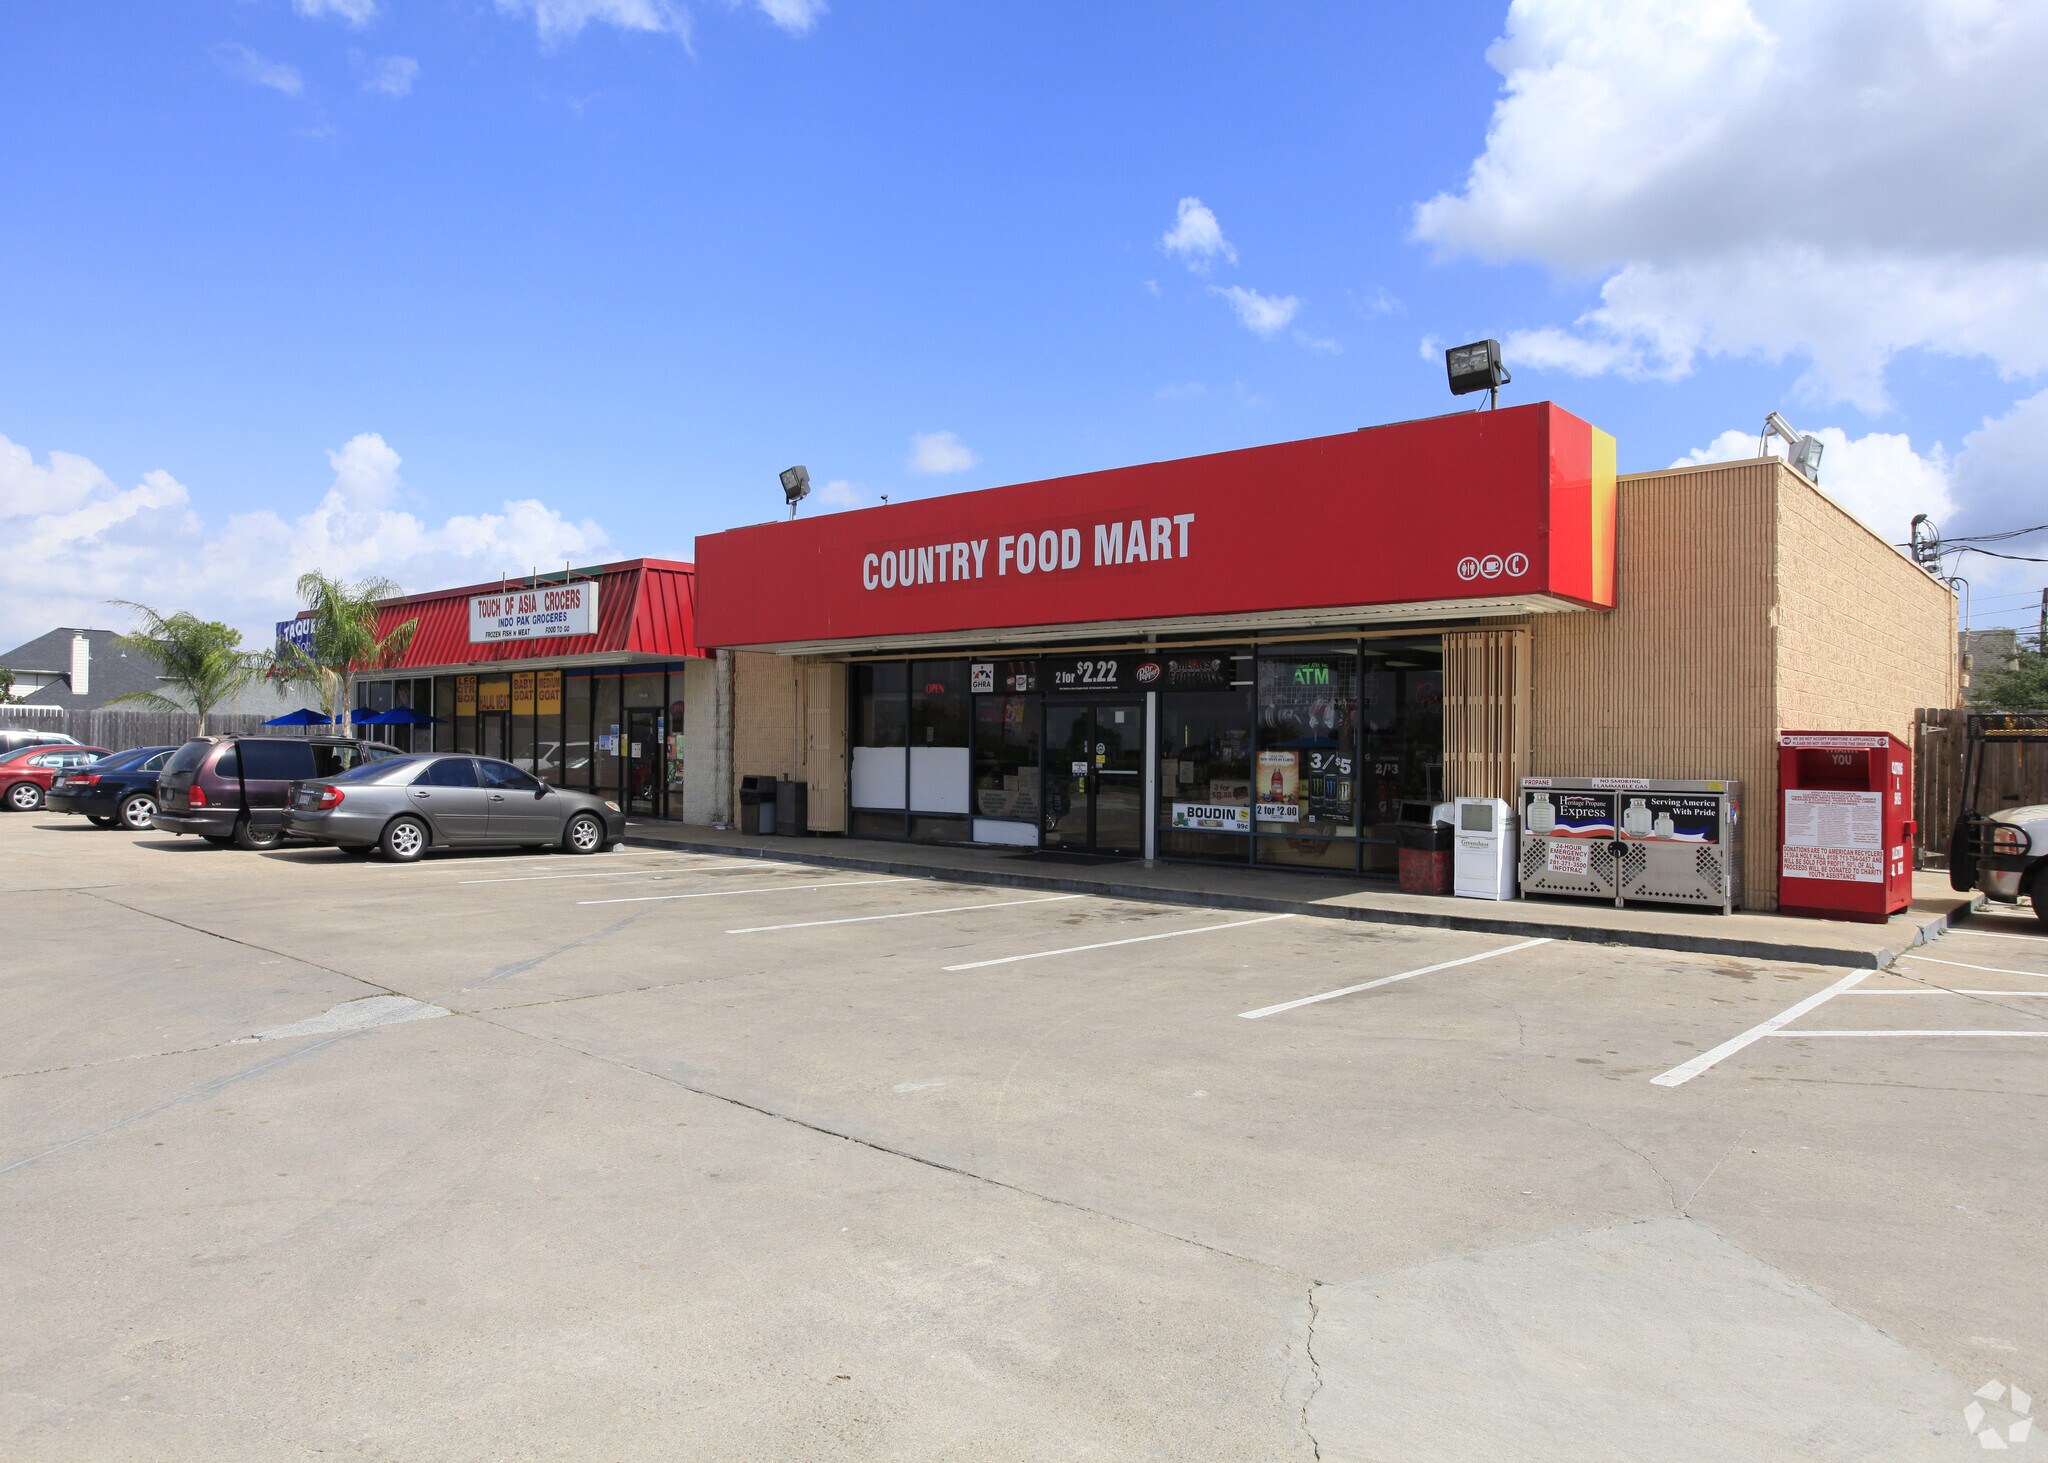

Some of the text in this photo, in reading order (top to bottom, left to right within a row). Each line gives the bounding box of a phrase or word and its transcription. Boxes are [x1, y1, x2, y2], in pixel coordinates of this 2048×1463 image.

[863, 513, 1195, 590] COUNTRY FOOD MART
[478, 598, 501, 619] TOUCH
[504, 596, 514, 616] OF
[518, 593, 537, 614] ASIA
[498, 611, 567, 628] INDO PAK GROCERES
[485, 630, 501, 639] FROZEN
[518, 628, 530, 636] MEAT
[545, 626, 556, 634] FOOD
[1055, 660, 1117, 683] 2 for $2.22
[1292, 668, 1329, 685] ATM
[458, 676, 475, 685] LEG
[513, 678, 533, 690] BABY
[538, 677, 560, 688] MEDIUM
[925, 683, 945, 694] OPEN
[457, 694, 476, 703] BOX
[514, 690, 534, 700] GOAT
[538, 689, 559, 700] GOAT
[496, 694, 510, 709] MEAT
[1832, 754, 1852, 765] YOU
[1560, 795, 1585, 806] Heritage
[1651, 798, 1716, 807] Serving America
[1187, 806, 1236, 820] BOUDIN
[1257, 805, 1297, 816] 2 for $2.00
[1560, 805, 1606, 818] Express
[1694, 808, 1716, 816] Pride
[1550, 848, 1588, 857] EMERGENCY
[1556, 843, 1582, 851] 24-HOUR
[1855, 849, 1882, 857] RECYCLERS
[1552, 865, 1583, 873] INFOTRAC
[1861, 868, 1882, 876] CHARITY
[1826, 872, 1856, 880] ASSISTANCE
